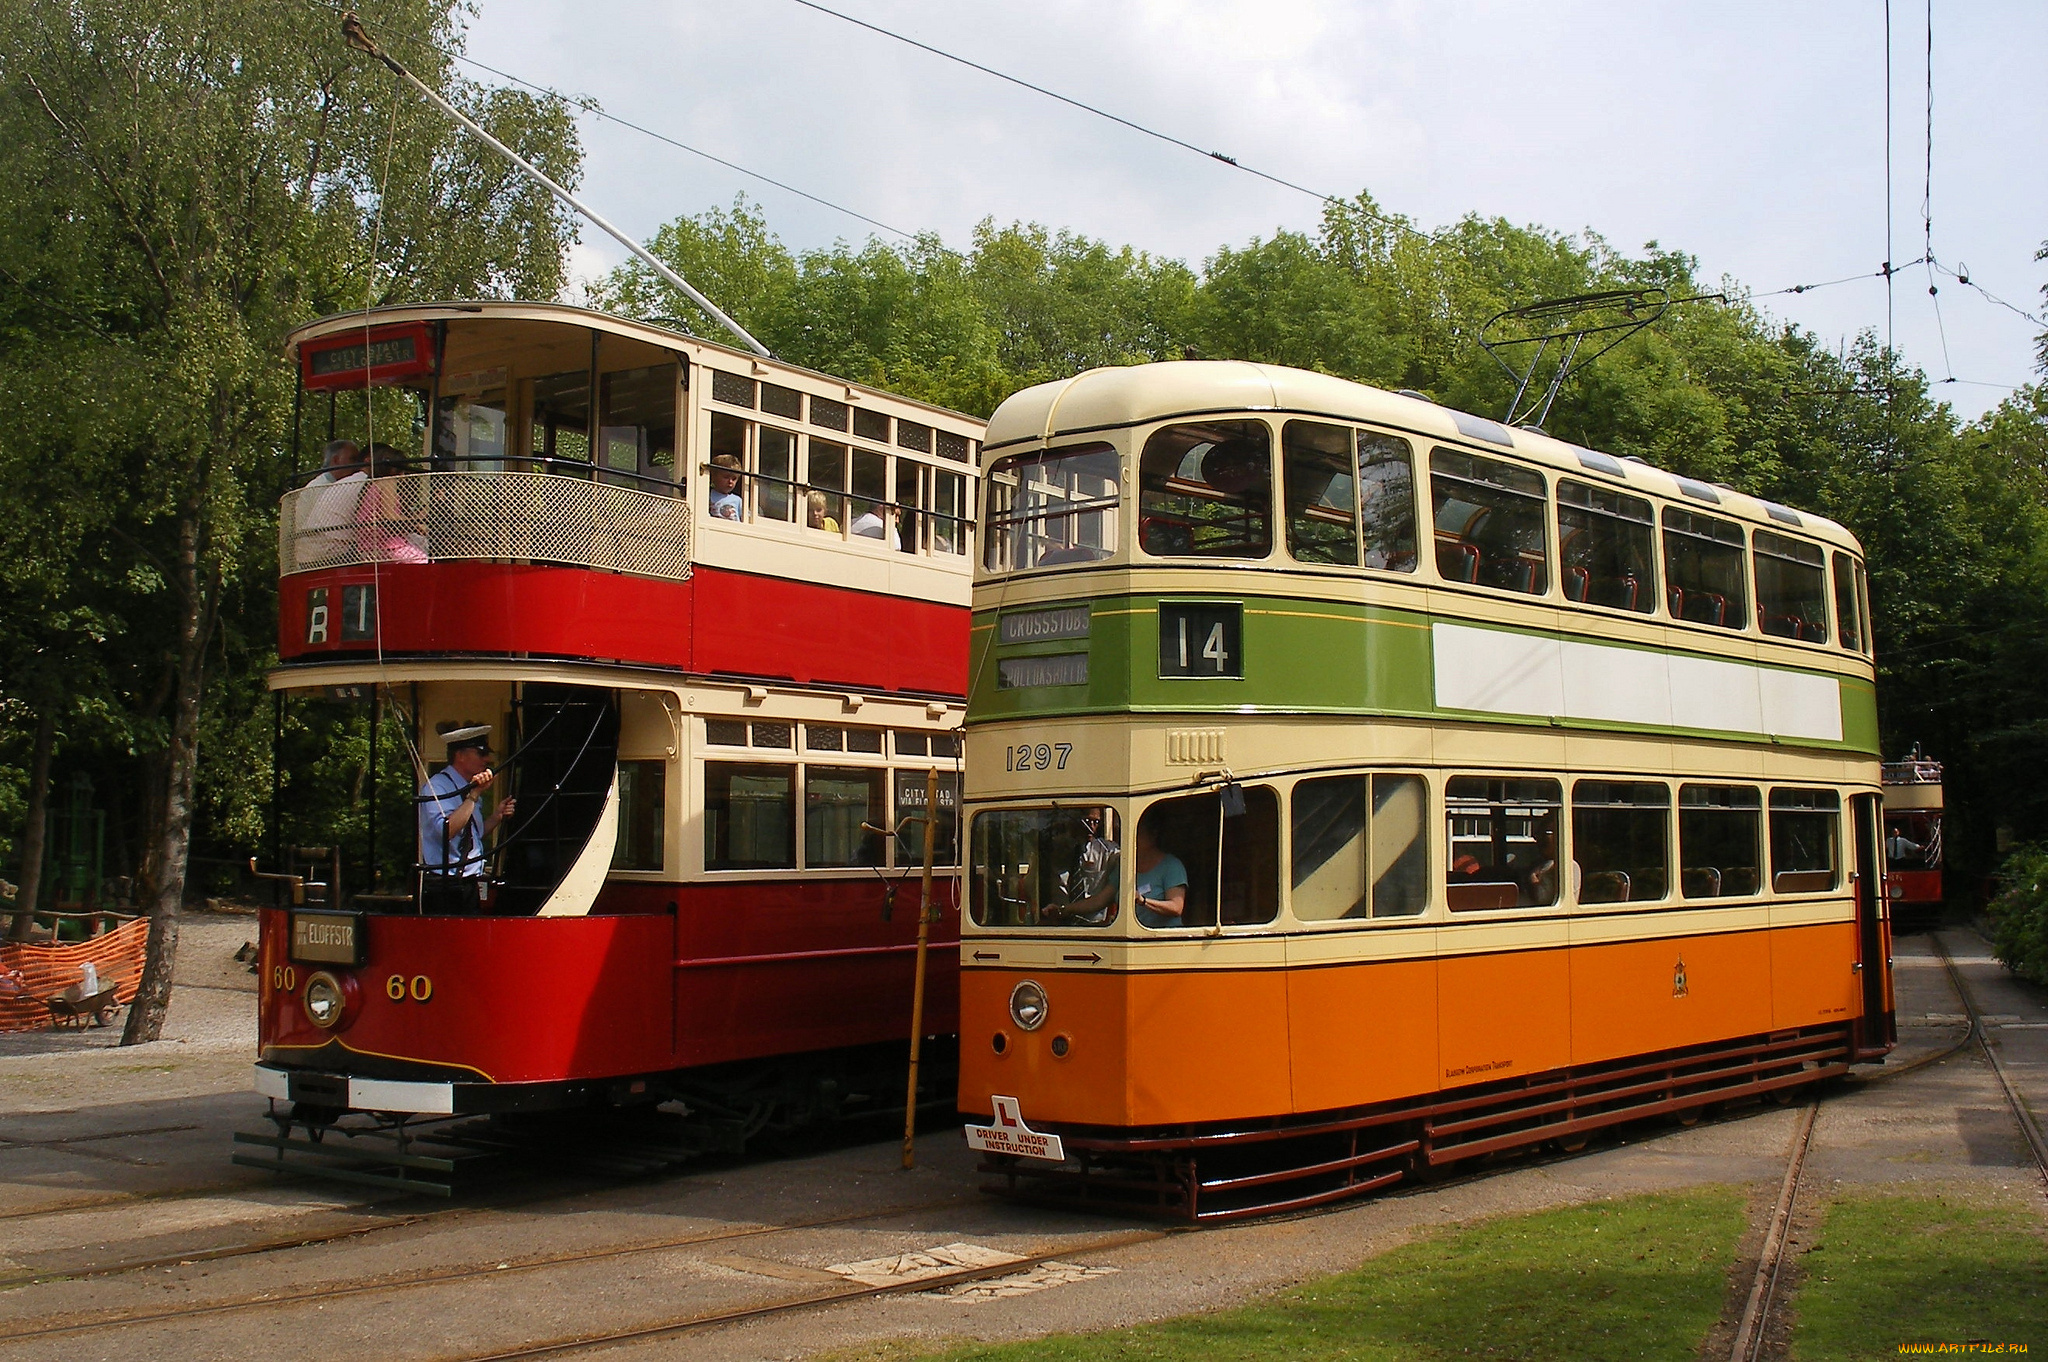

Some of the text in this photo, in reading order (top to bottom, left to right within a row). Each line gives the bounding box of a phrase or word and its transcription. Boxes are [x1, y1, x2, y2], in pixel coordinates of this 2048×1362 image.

[1179, 617, 1229, 672] 14
[1006, 743, 1073, 771] 1297
[274, 965, 295, 991] 60
[386, 974, 432, 1001] 60
[998, 1102, 1017, 1127] L
[976, 1129, 1049, 1147] DRIVER UNDER
[985, 1140, 1046, 1156] INSTRUCTION
